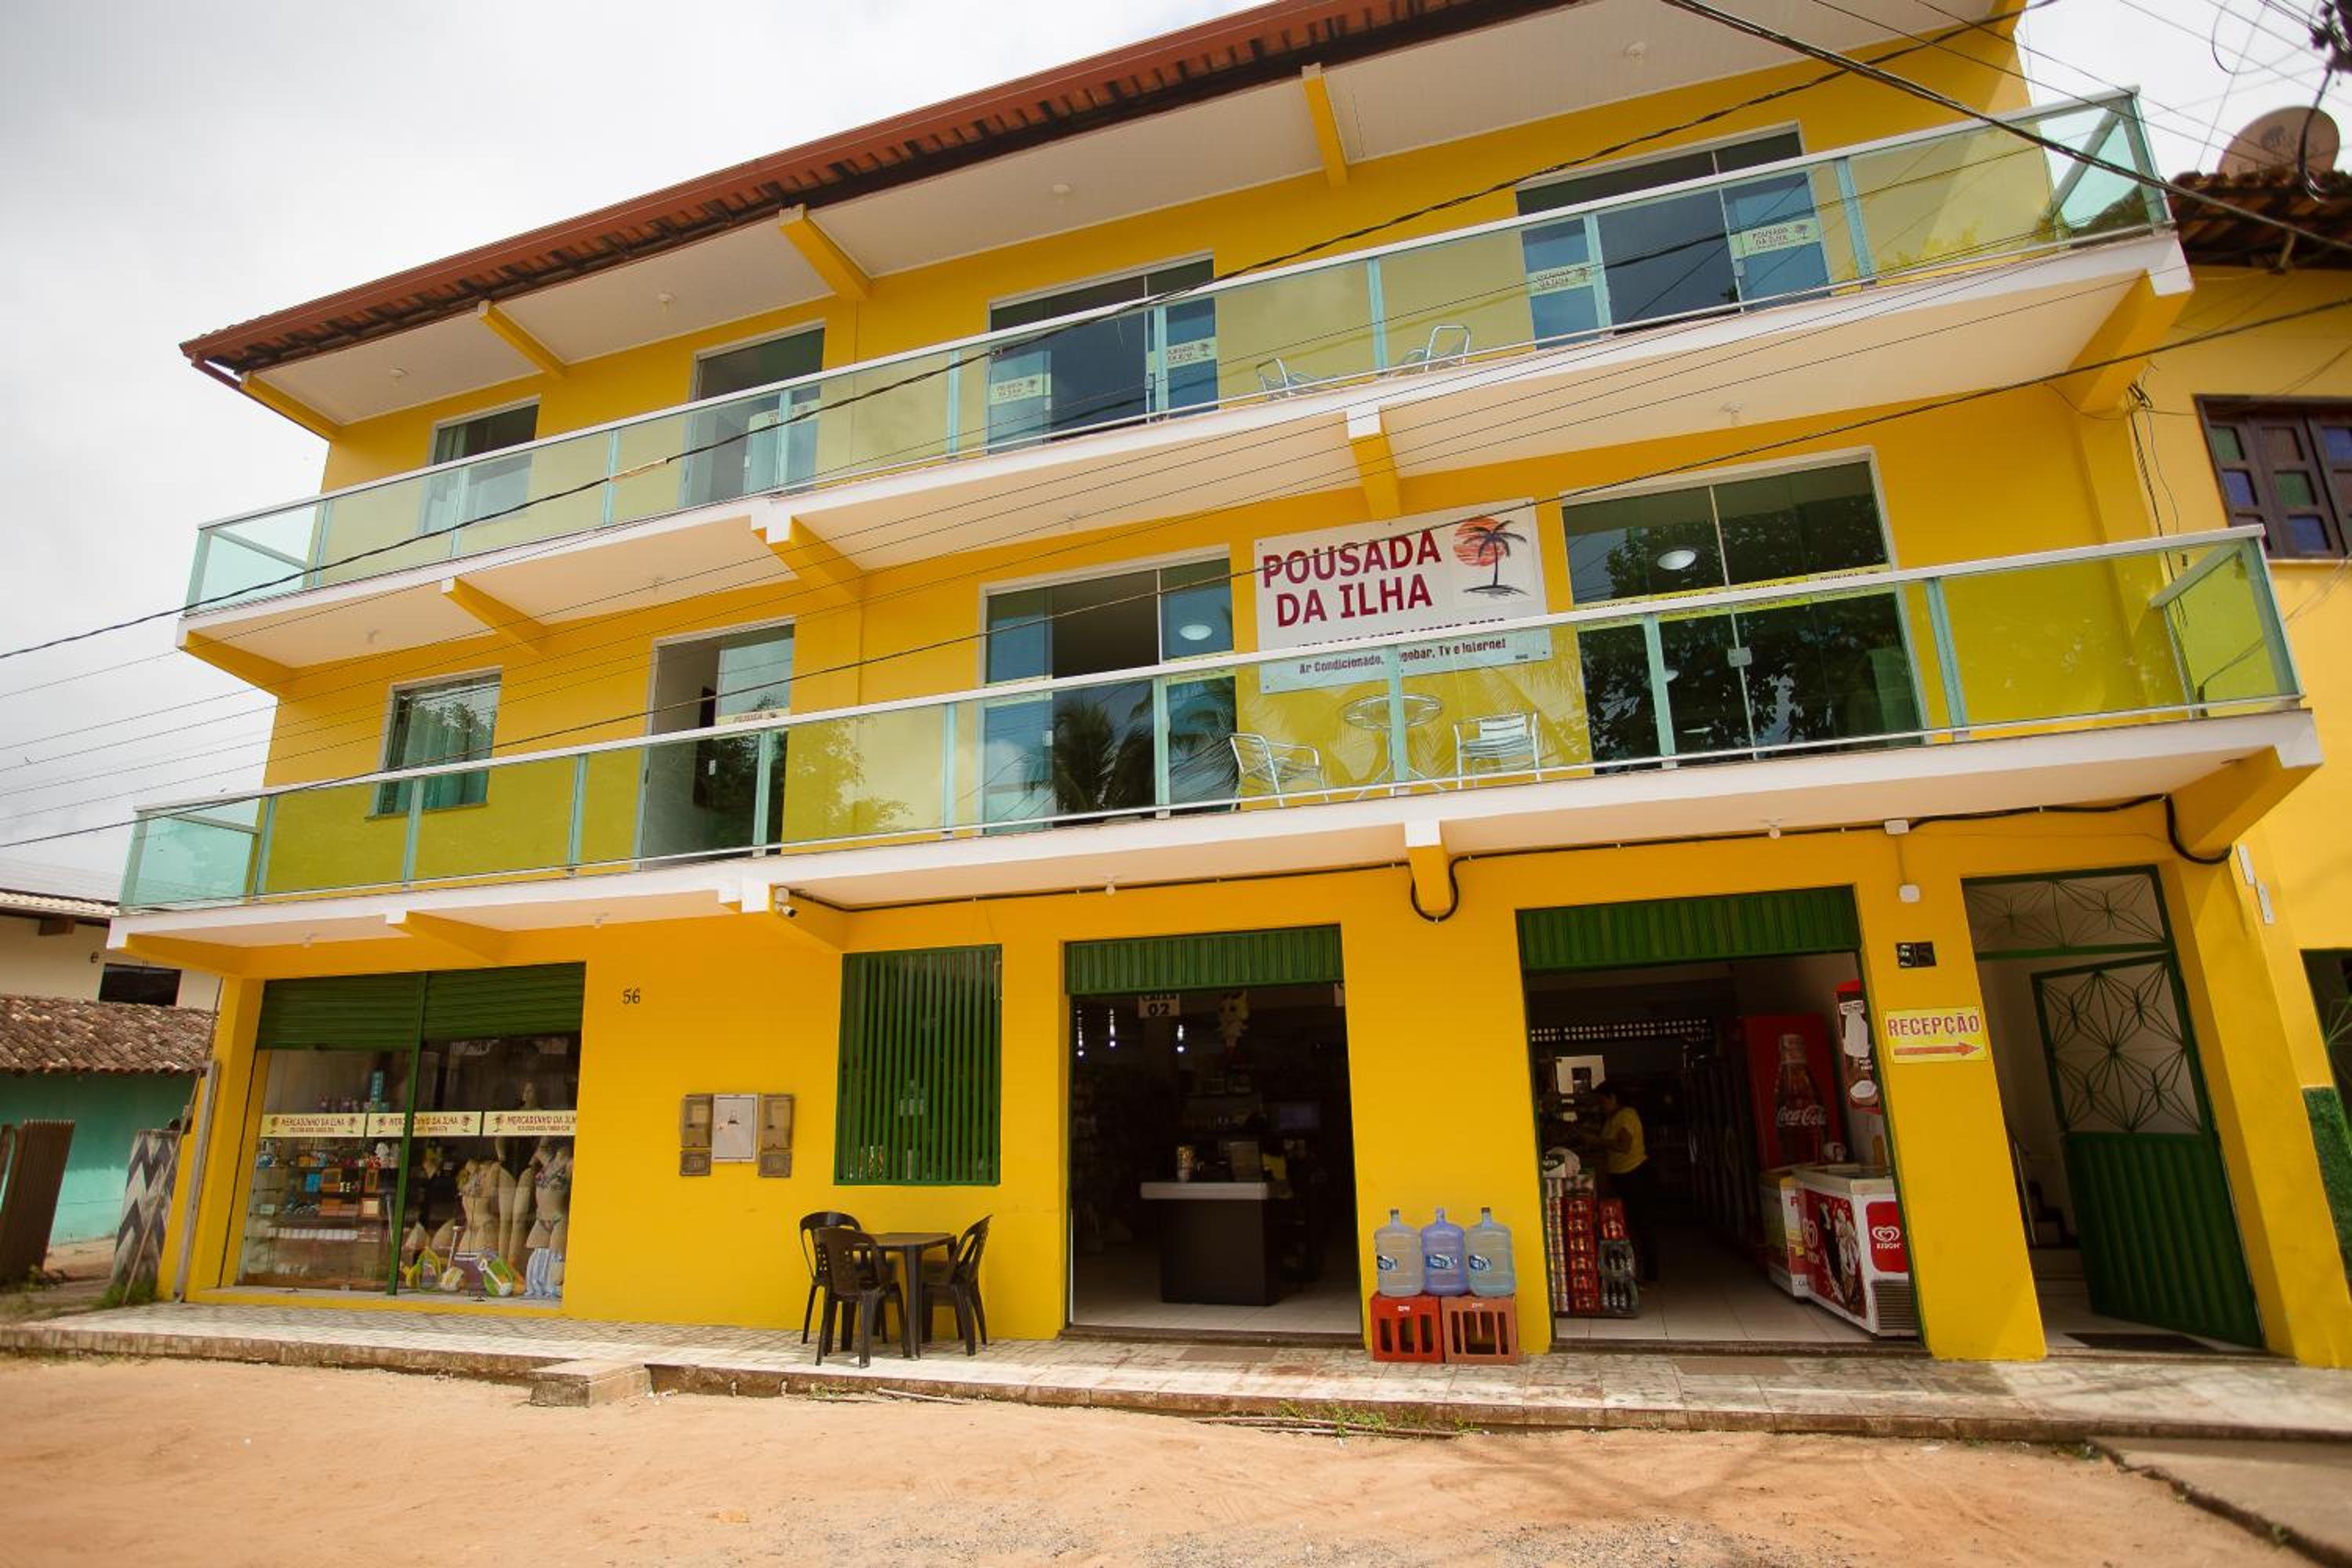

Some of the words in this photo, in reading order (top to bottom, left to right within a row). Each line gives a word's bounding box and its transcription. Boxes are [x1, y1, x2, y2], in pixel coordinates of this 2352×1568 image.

[1263, 529, 1442, 588] POUSADA
[1276, 588, 1328, 627] DA
[1339, 574, 1434, 619] ILHA
[1439, 645, 1451, 655] Tv
[1462, 637, 1506, 653] Internet
[622, 987, 641, 1004] 56
[1148, 1003, 1170, 1017] 02
[1887, 1012, 1980, 1037] RECEPÇÃO
